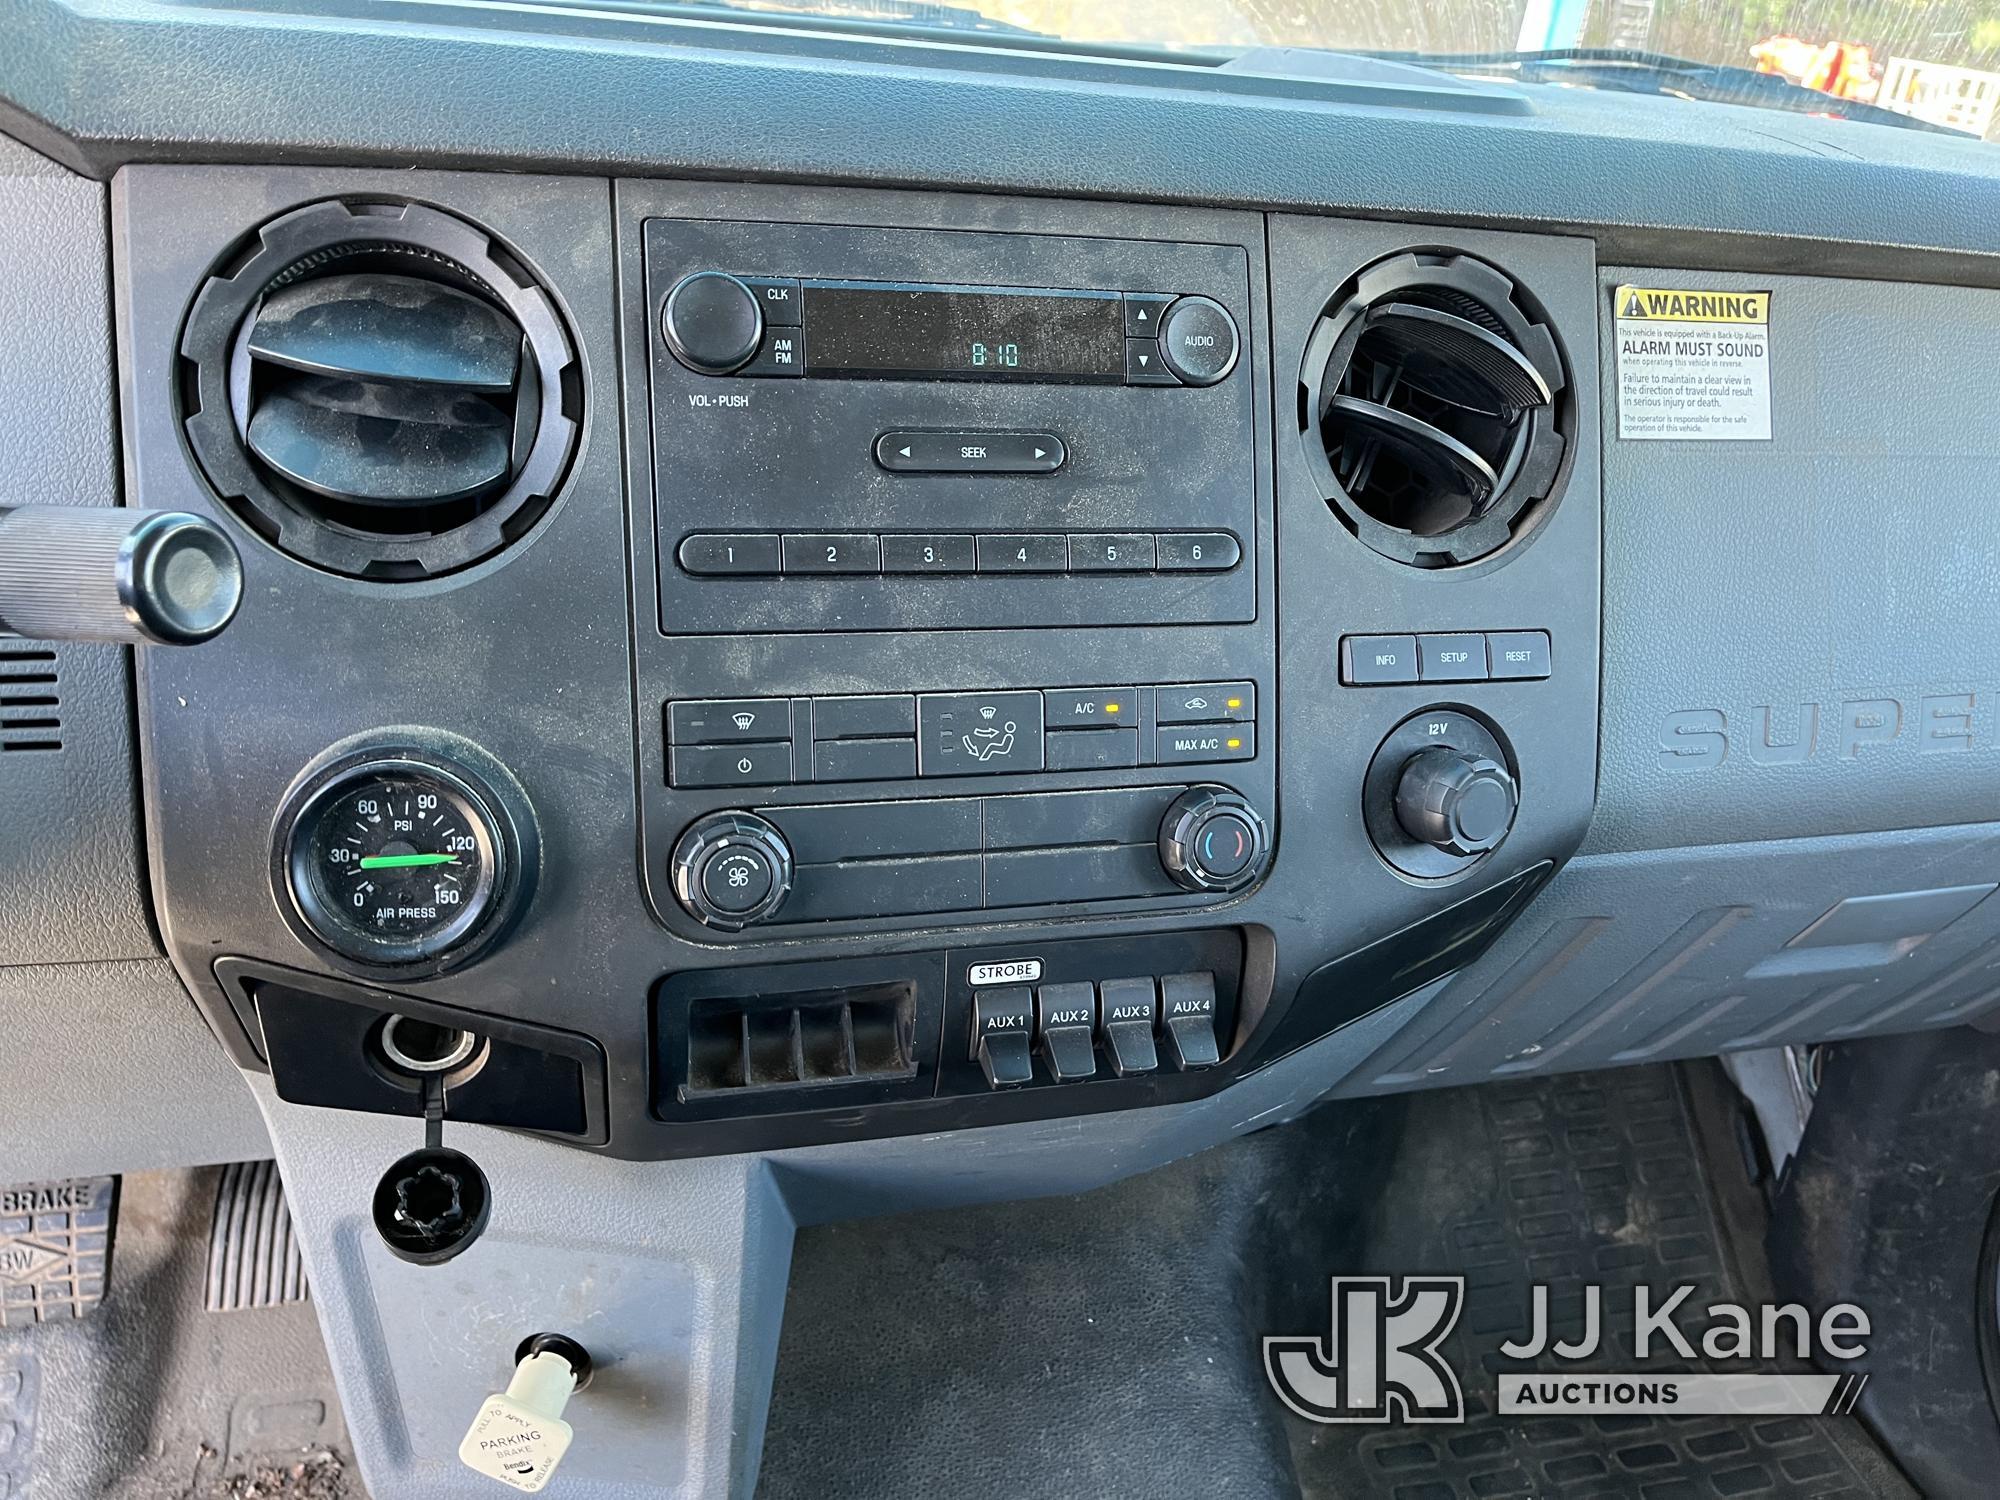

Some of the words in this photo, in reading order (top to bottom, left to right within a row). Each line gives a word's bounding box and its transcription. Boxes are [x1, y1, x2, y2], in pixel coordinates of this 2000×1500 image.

[768, 288, 788, 300] CLK
[1647, 294, 1758, 318] WARNING
[1619, 328, 1632, 336] This
[1633, 329, 1656, 337] vehicle
[1657, 329, 1662, 337] is
[1664, 330, 1694, 339] equipped
[1717, 331, 1743, 341] Back-Up
[774, 340, 792, 350] AM
[1184, 336, 1214, 347] AUDIO
[972, 344, 1018, 366] 8:10
[1622, 341, 1670, 354] ALARM
[1676, 342, 1712, 355] MUST
[1717, 343, 1763, 357] SOUND
[775, 353, 792, 363] FM
[1642, 359, 1672, 367] operating
[1624, 373, 1649, 383] Failure
[1651, 375, 1659, 383] to
[1662, 374, 1696, 384] maintain
[1705, 375, 1722, 384] clear
[1724, 376, 1741, 385] view
[1744, 376, 1751, 385] in
[1624, 385, 1637, 395] the
[1639, 385, 1673, 395] direction
[1676, 386, 1684, 395] of
[1686, 386, 1707, 395] travel
[1709, 386, 1730, 396] could
[1732, 387, 1753, 396] result
[1624, 396, 1632, 406] in
[1633, 397, 1661, 406] serious
[1663, 398, 1684, 409] injury
[1697, 397, 1721, 407] death.
[1637, 416, 1665, 424] operator
[1674, 416, 1710, 424] responsible
[1734, 416, 1747, 424] safe
[1624, 424, 1656, 432] operation
[1666, 424, 1678, 432] this
[961, 446, 986, 458] SEEK
[728, 548, 734, 561] 1
[826, 546, 837, 561] 2
[924, 547, 934, 562] 3
[1016, 548, 1027, 562] 4
[1107, 546, 1116, 560] 5
[1192, 546, 1202, 560] 6
[1376, 655, 1396, 665] INFO
[1441, 653, 1468, 663] SETUP
[1506, 651, 1531, 661] RESET
[1075, 702, 1094, 714] A/C
[1429, 723, 1448, 735] 12V
[1659, 690, 2000, 771] SUPE
[1175, 738, 1198, 751] MAX
[1200, 738, 1218, 750] A/C
[358, 800, 377, 815] 60
[417, 795, 437, 809] 90
[394, 820, 413, 831] PSI
[451, 836, 475, 850] 120
[331, 849, 349, 863] 30
[354, 893, 363, 906] 0
[435, 890, 459, 904] 150
[376, 908, 395, 919] AIR
[399, 908, 436, 918] PRESS
[979, 963, 1032, 979] STROBE
[1113, 1006, 1138, 1019] AUX
[1139, 1006, 1150, 1016] 3
[1174, 1000, 1199, 1013] AUX
[1199, 1000, 1210, 1011] 4
[987, 1016, 1014, 1029] AUX
[1018, 1015, 1025, 1026] 1
[1051, 1011, 1077, 1023] AUX
[1080, 1010, 1088, 1021] 2
[0, 1185, 90, 1213] BRAKE
[480, 1431, 541, 1450] PARKING
[496, 1445, 533, 1458] BRAKE
[503, 1461, 530, 1470] Bendix
[535, 1456, 553, 1481] RELEASE
